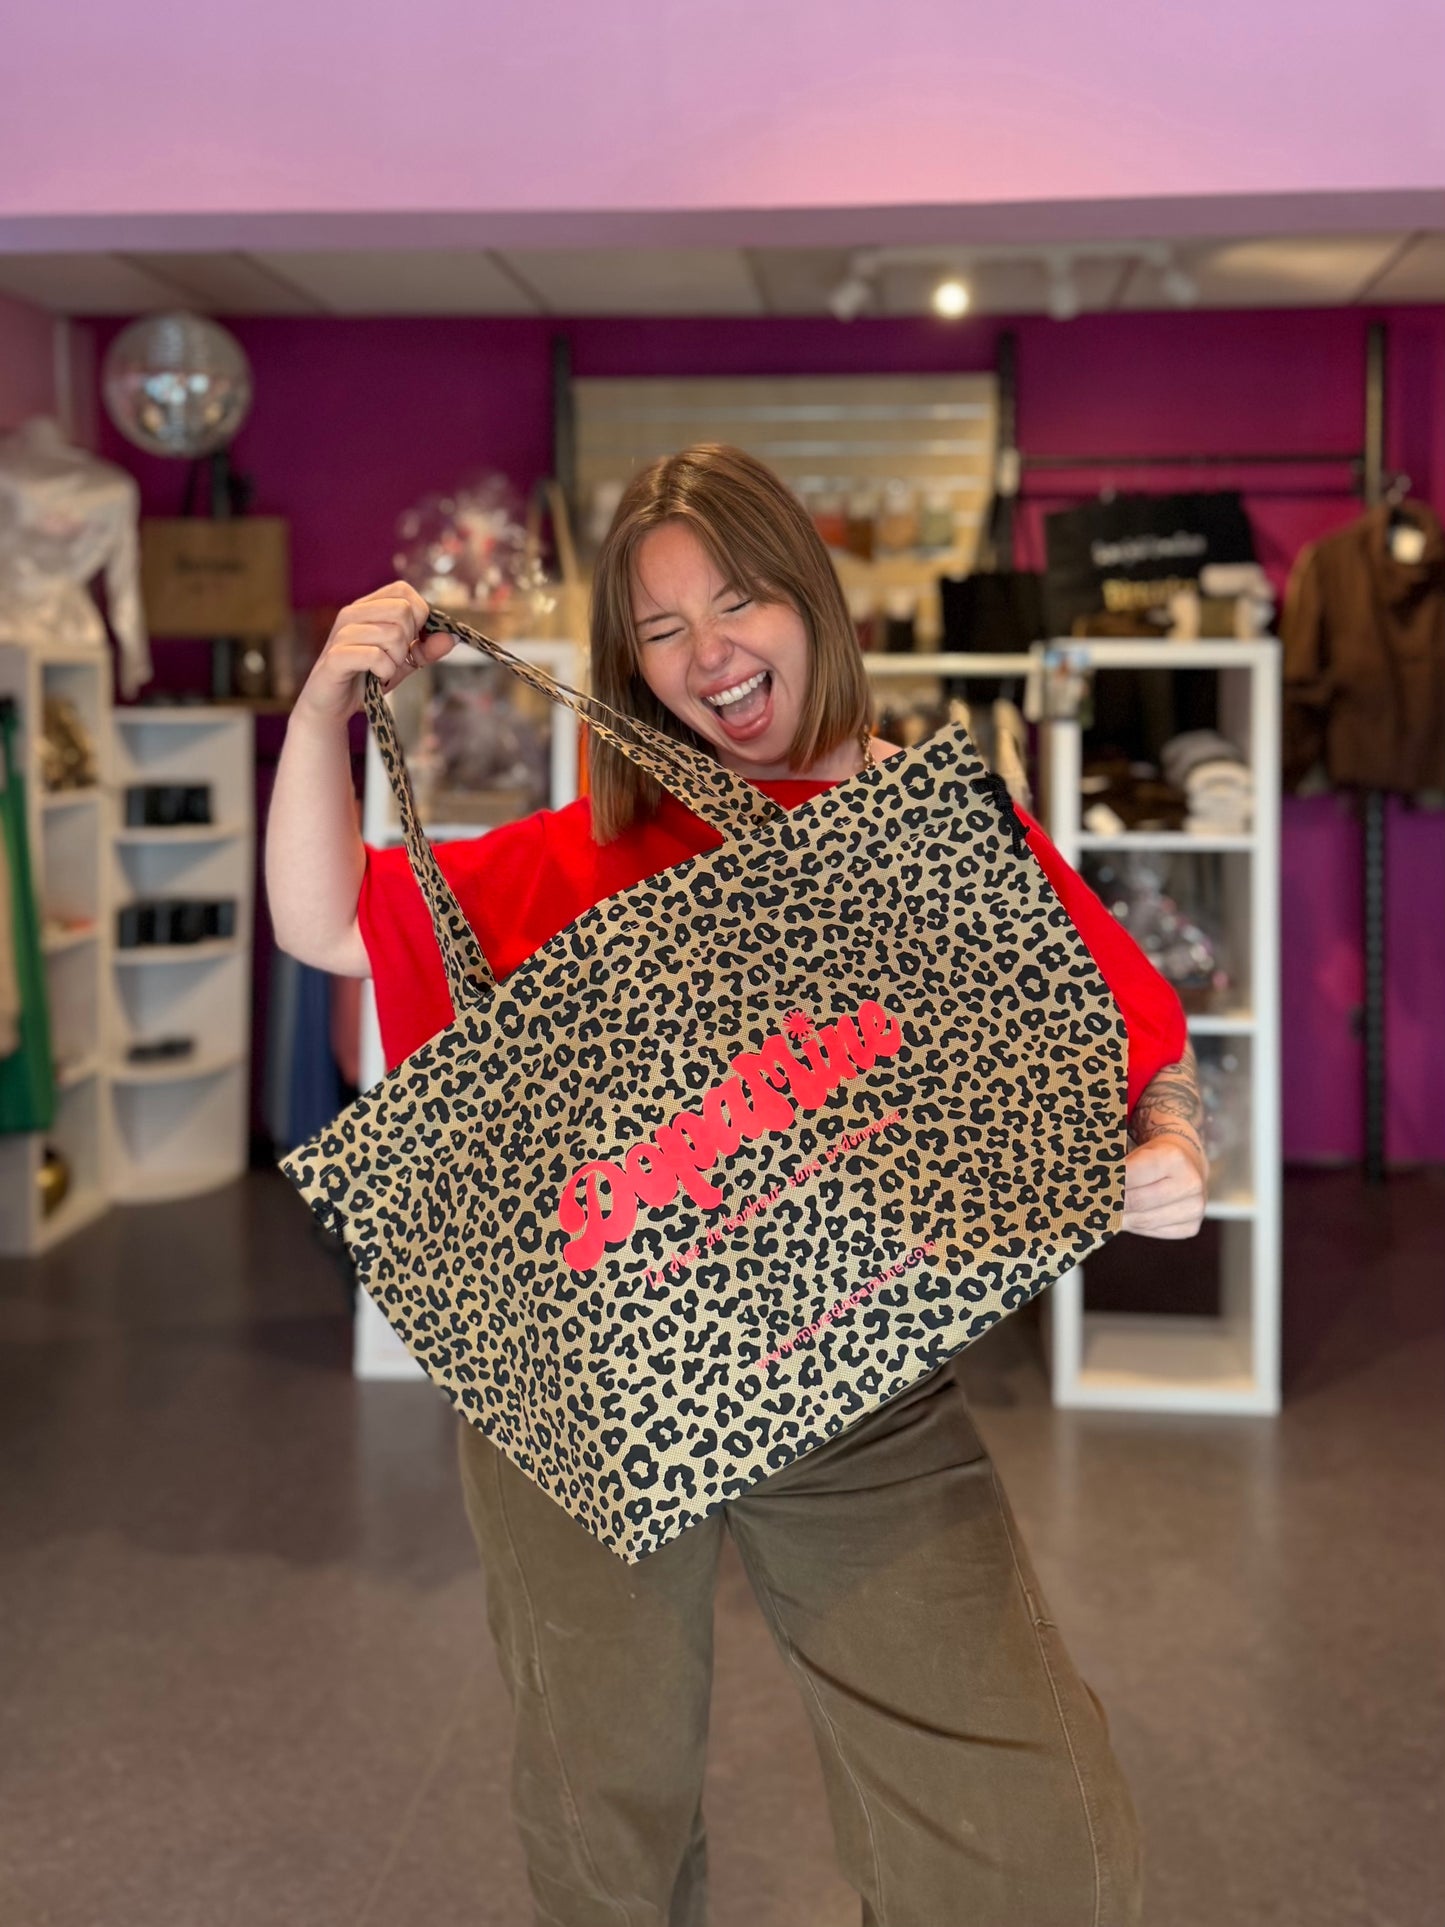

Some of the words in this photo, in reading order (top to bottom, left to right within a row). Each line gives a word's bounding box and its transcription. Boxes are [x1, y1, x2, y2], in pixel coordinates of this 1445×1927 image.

[642, 1266, 665, 1289] Ta
[668, 1244, 701, 1274] dose
[706, 1226, 722, 1249] de
[722, 1185, 781, 1231] bonheur
[787, 1159, 821, 1188] sans
[754, 1240, 936, 1369] www.moredopamine.com
